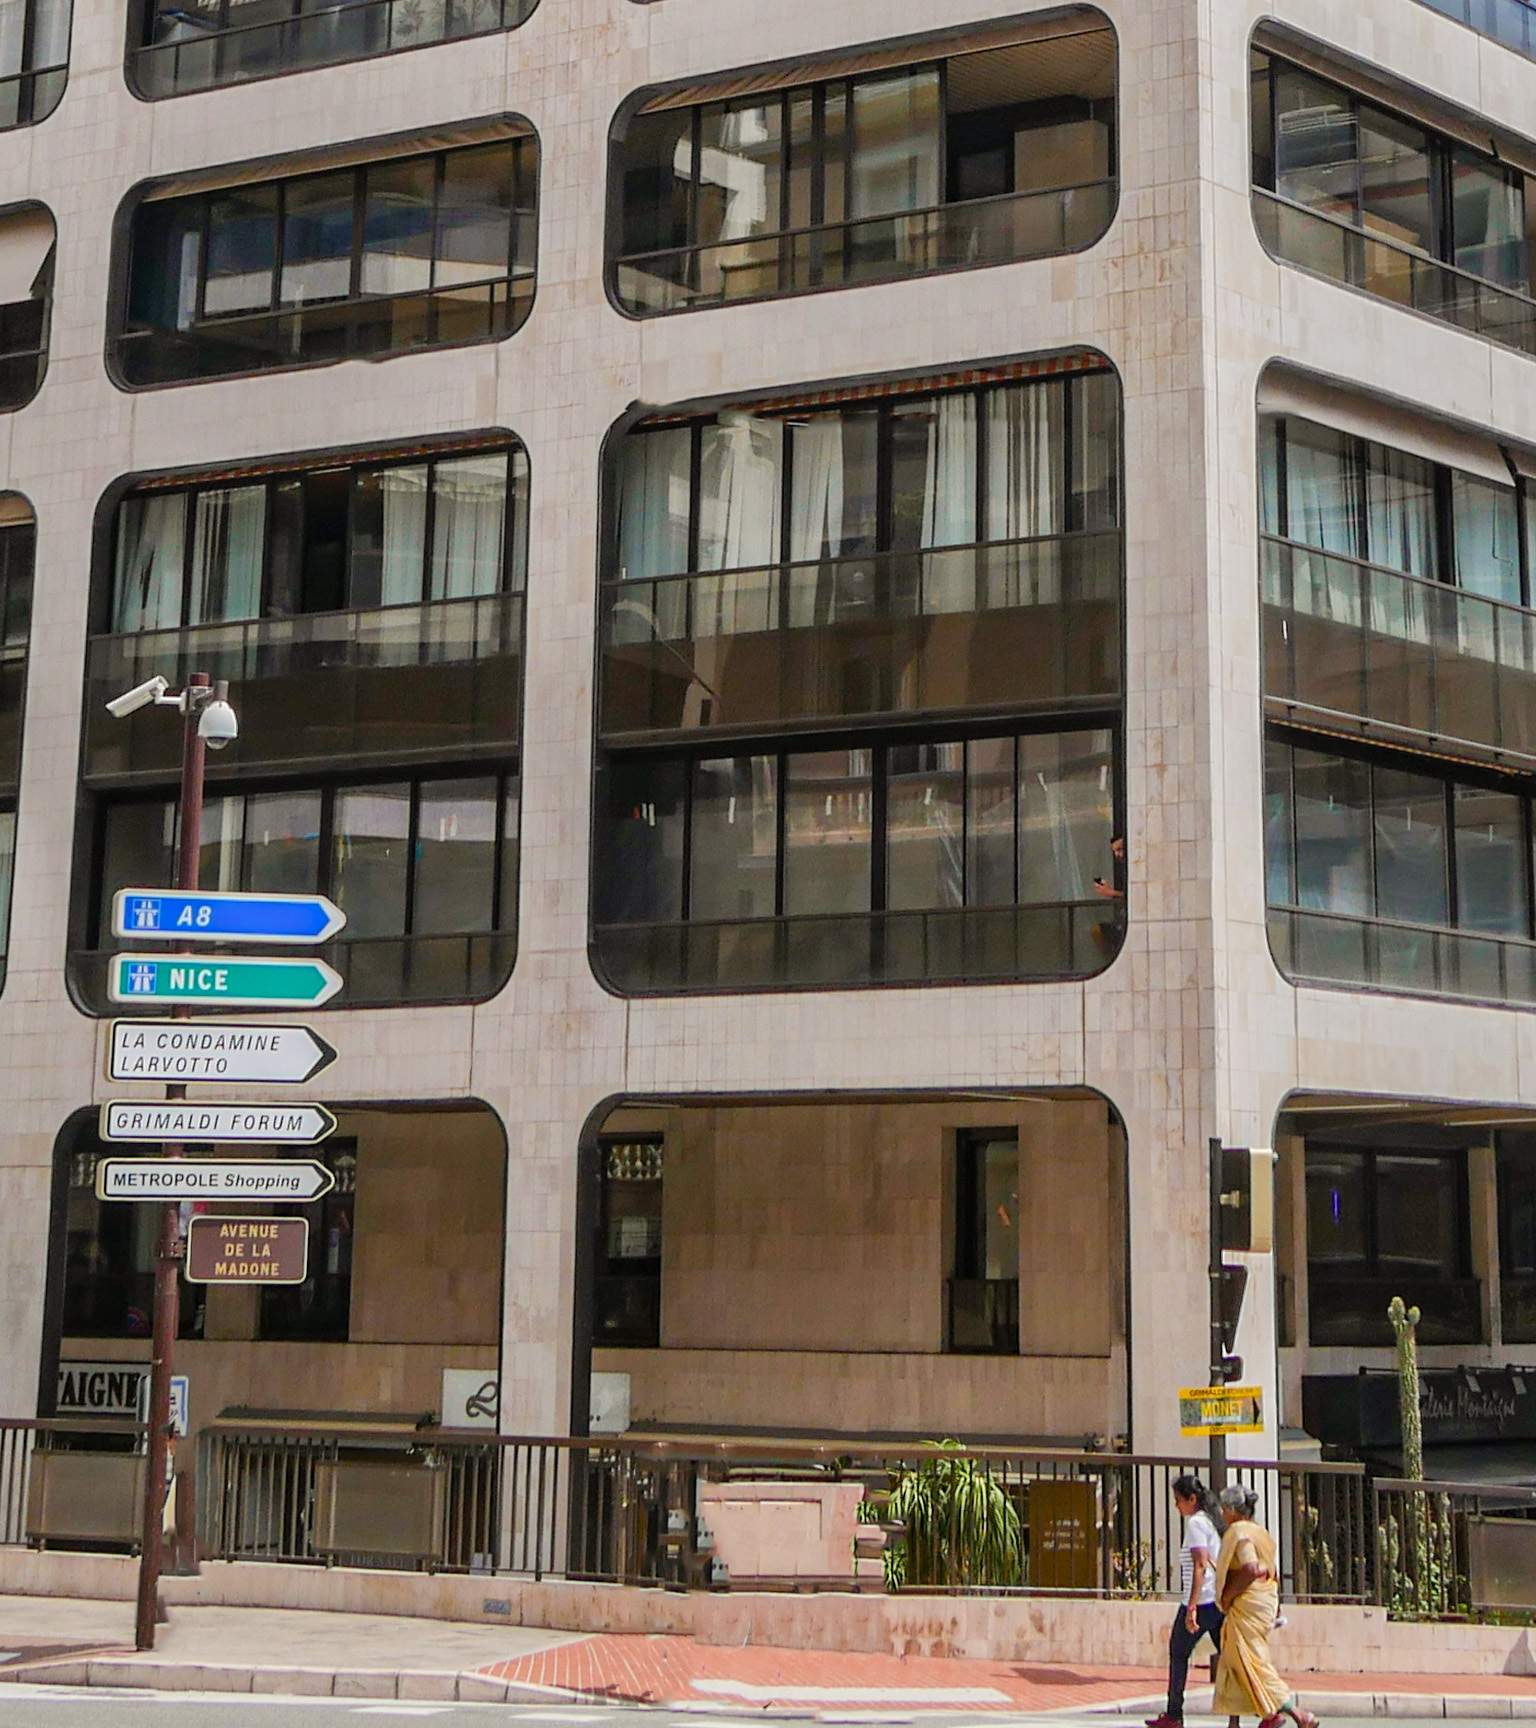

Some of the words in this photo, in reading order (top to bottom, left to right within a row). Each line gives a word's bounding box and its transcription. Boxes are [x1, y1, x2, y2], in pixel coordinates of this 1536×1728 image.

[177, 905, 212, 926] A8
[169, 969, 228, 991] NICE
[122, 1033, 145, 1049] LA
[157, 1034, 281, 1051] CONDAMINE
[121, 1057, 228, 1073] LARVOTTO
[116, 1113, 219, 1130] GRIMALDI
[230, 1115, 303, 1131] FORUM
[114, 1173, 219, 1187] METROPOLE
[224, 1174, 301, 1190] Shopping
[219, 1224, 279, 1238] AVENUE
[225, 1243, 244, 1256] DE
[252, 1243, 271, 1256] LA
[215, 1262, 279, 1276] MADONE
[1200, 1400, 1243, 1417] MONET
